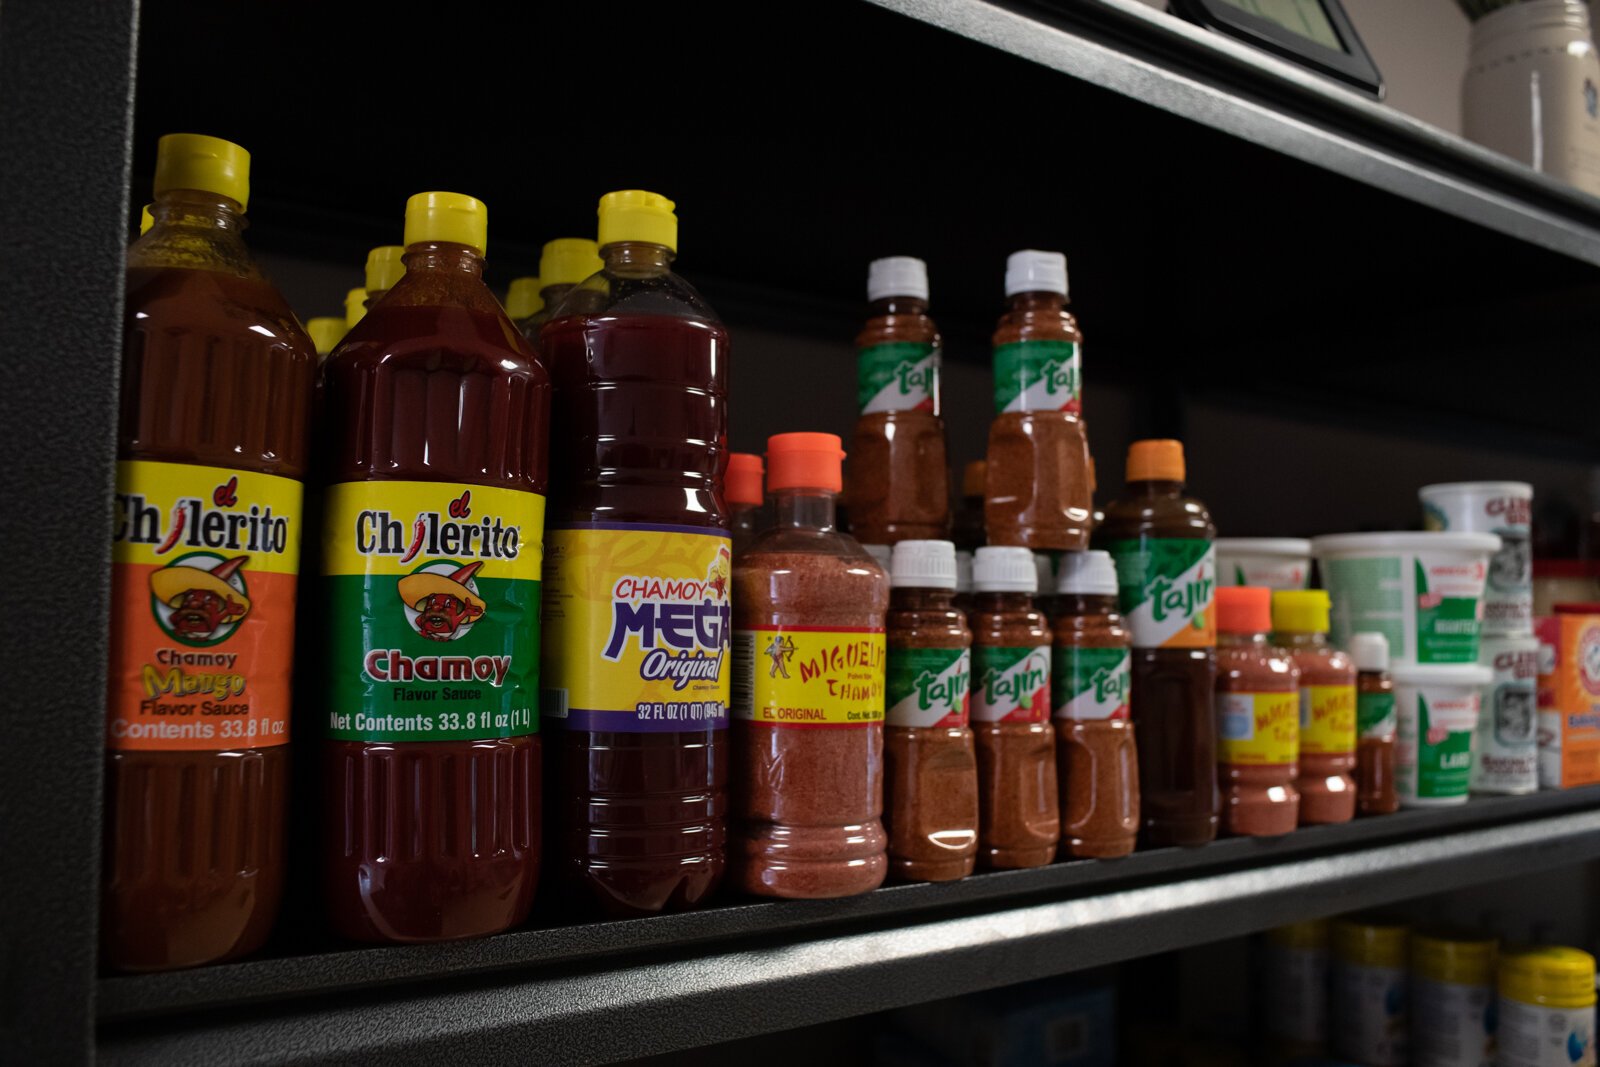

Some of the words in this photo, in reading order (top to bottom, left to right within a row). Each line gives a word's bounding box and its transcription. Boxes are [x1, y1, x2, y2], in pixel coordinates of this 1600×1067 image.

[213, 476, 237, 507] el
[449, 490, 471, 518] el
[615, 579, 708, 600] CHAMOY
[604, 601, 730, 660] MEGA
[157, 650, 237, 668] Chamoy
[364, 649, 512, 688] Chamoy
[641, 650, 723, 690] Original
[142, 664, 246, 701] Mango
[394, 688, 437, 701] Flavor
[442, 688, 481, 701] Sauce
[140, 701, 196, 716] Flavor
[201, 702, 249, 716] Sauce
[638, 704, 651, 720] 32
[654, 704, 665, 720] FL
[667, 704, 678, 720] OZ
[778, 708, 828, 720] ORIGINAL
[112, 718, 214, 739] Contents
[220, 718, 257, 738] 33.8
[261, 717, 270, 736] fl
[272, 718, 285, 734] oz
[330, 712, 351, 730] Net
[355, 712, 433, 732] Contents
[438, 711, 476, 730] 33.8
[481, 710, 491, 728] fl
[495, 712, 508, 728] oz
